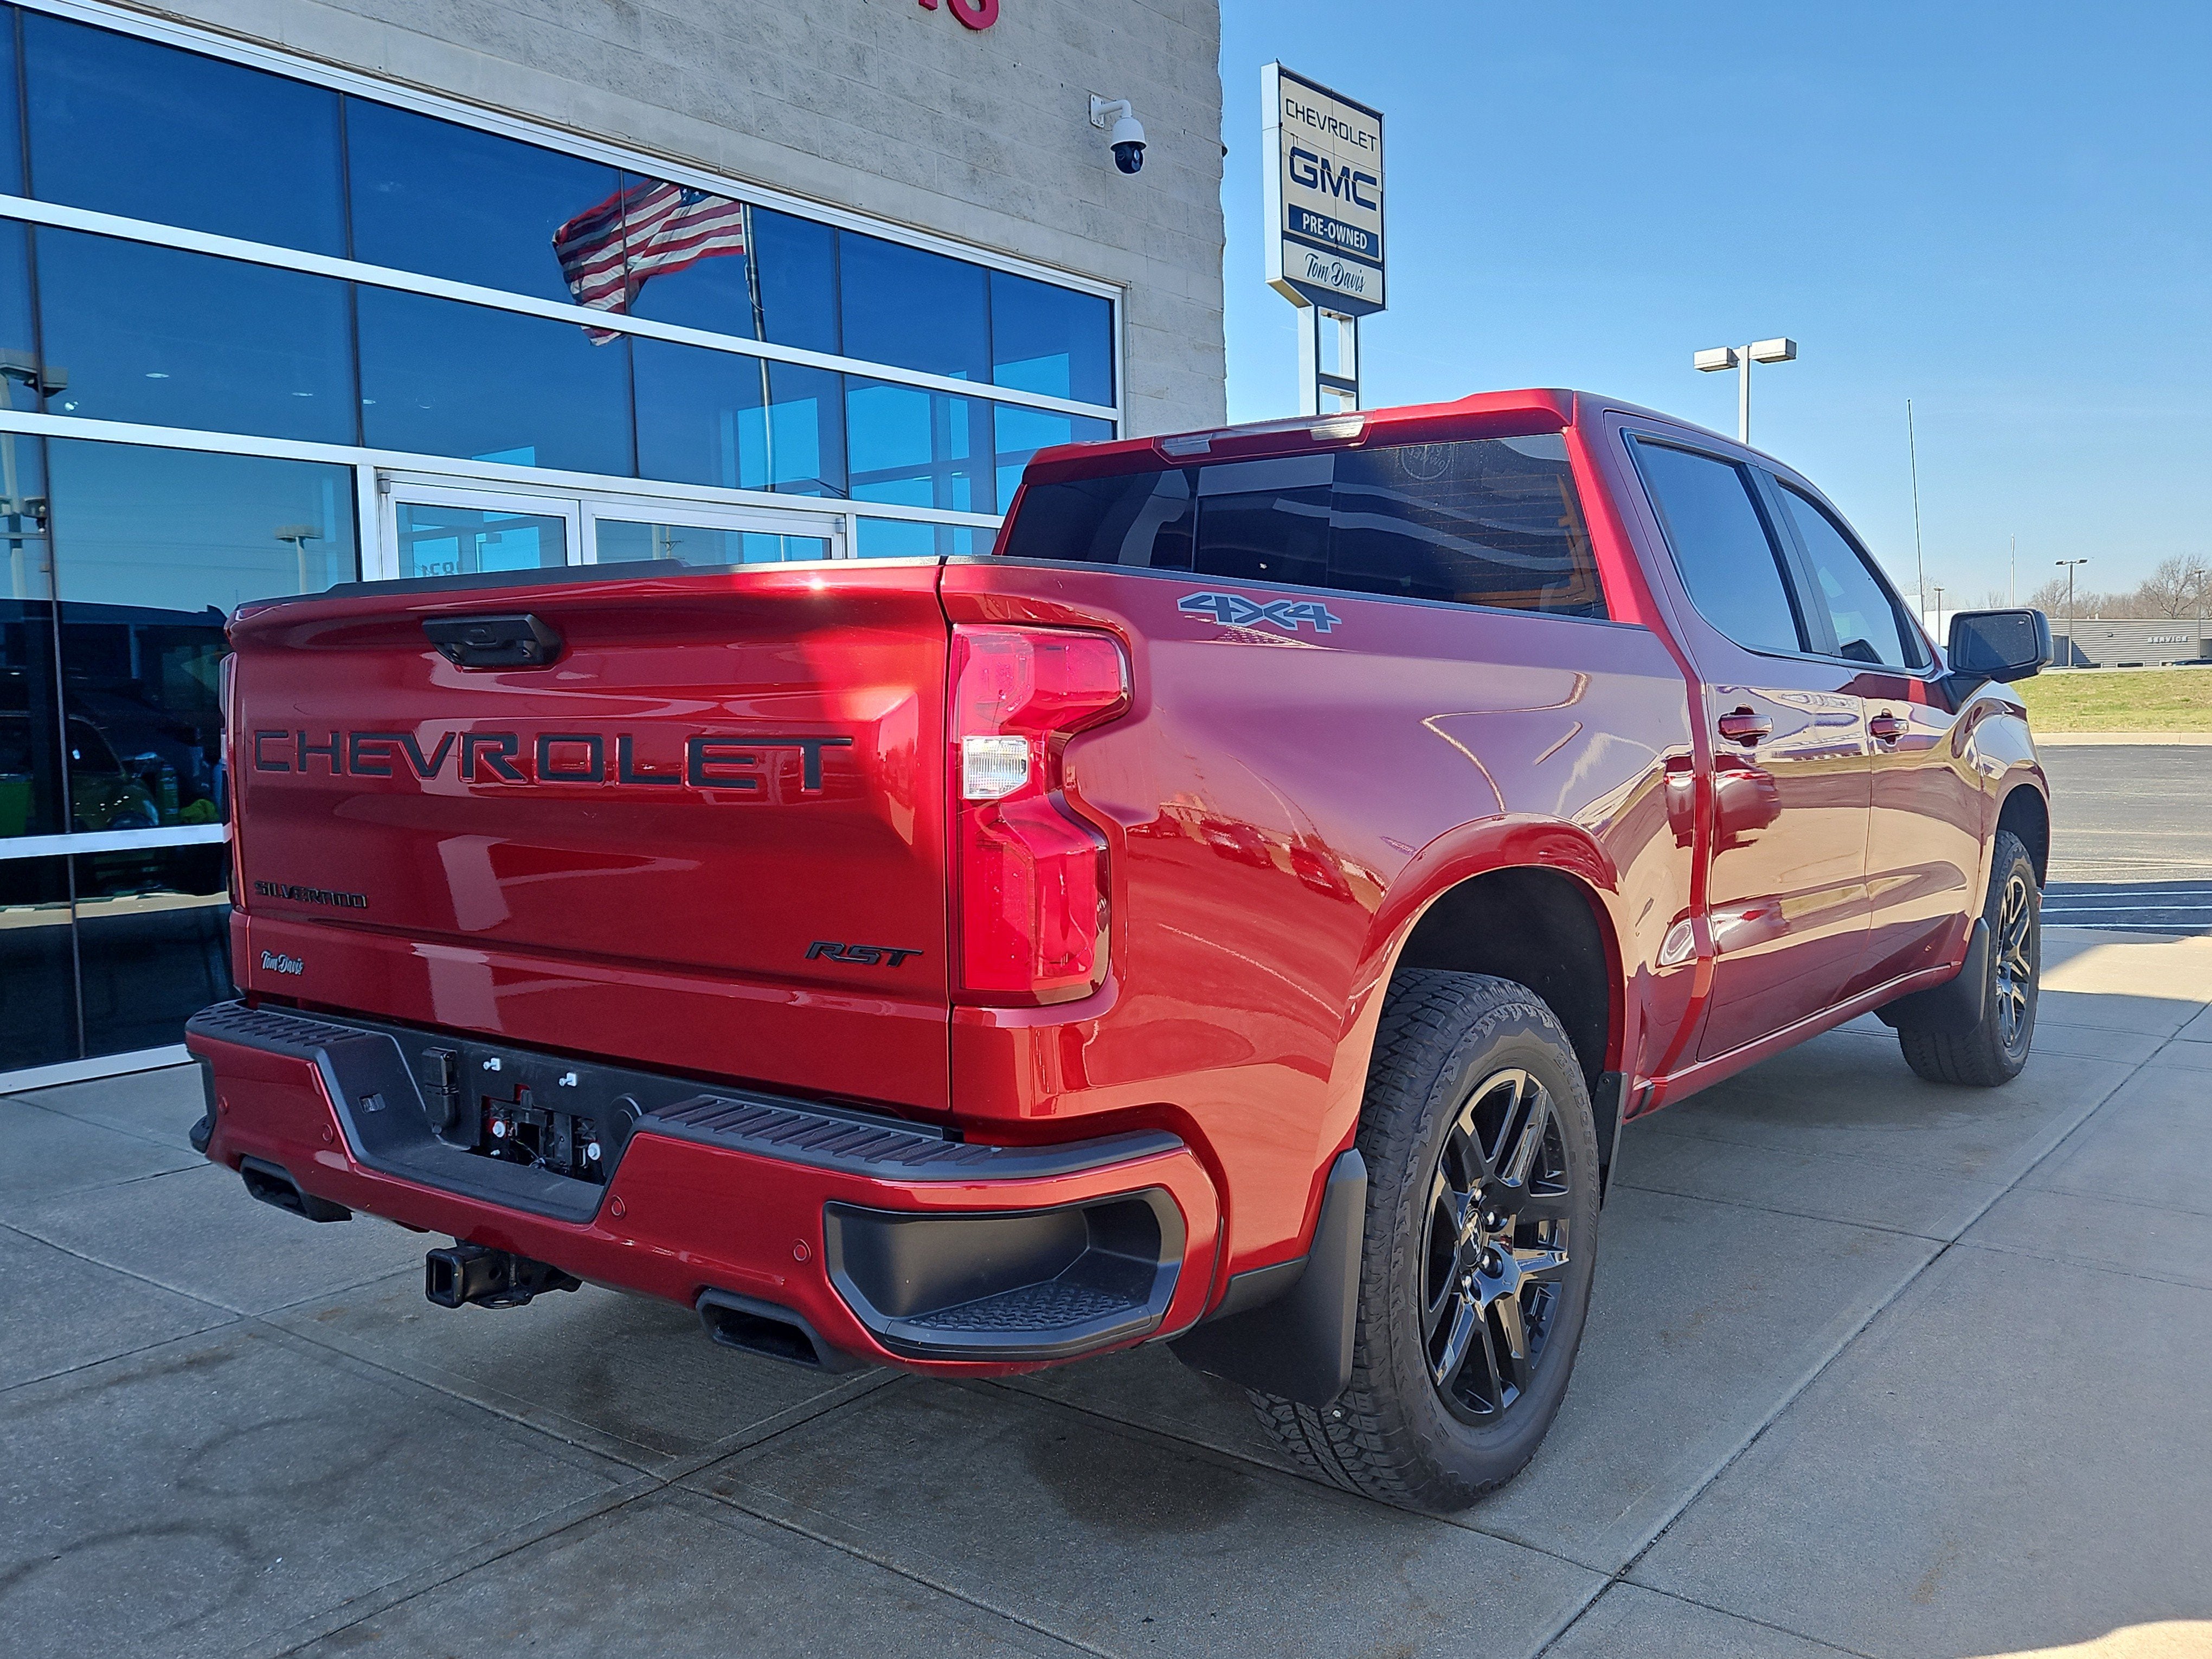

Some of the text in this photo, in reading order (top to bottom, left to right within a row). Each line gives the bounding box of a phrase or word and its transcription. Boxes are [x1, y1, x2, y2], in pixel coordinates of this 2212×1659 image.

[1285, 98, 1377, 152] CHEVROLET
[1289, 146, 1377, 211] GMC
[1302, 213, 1367, 250] PRE-OWNED
[1305, 253, 1366, 293] Tom Davis
[254, 730, 853, 793] CHEVROLET
[254, 880, 368, 909] SILVERADO
[261, 950, 304, 975] Tom Davis
[804, 940, 924, 968] RST
